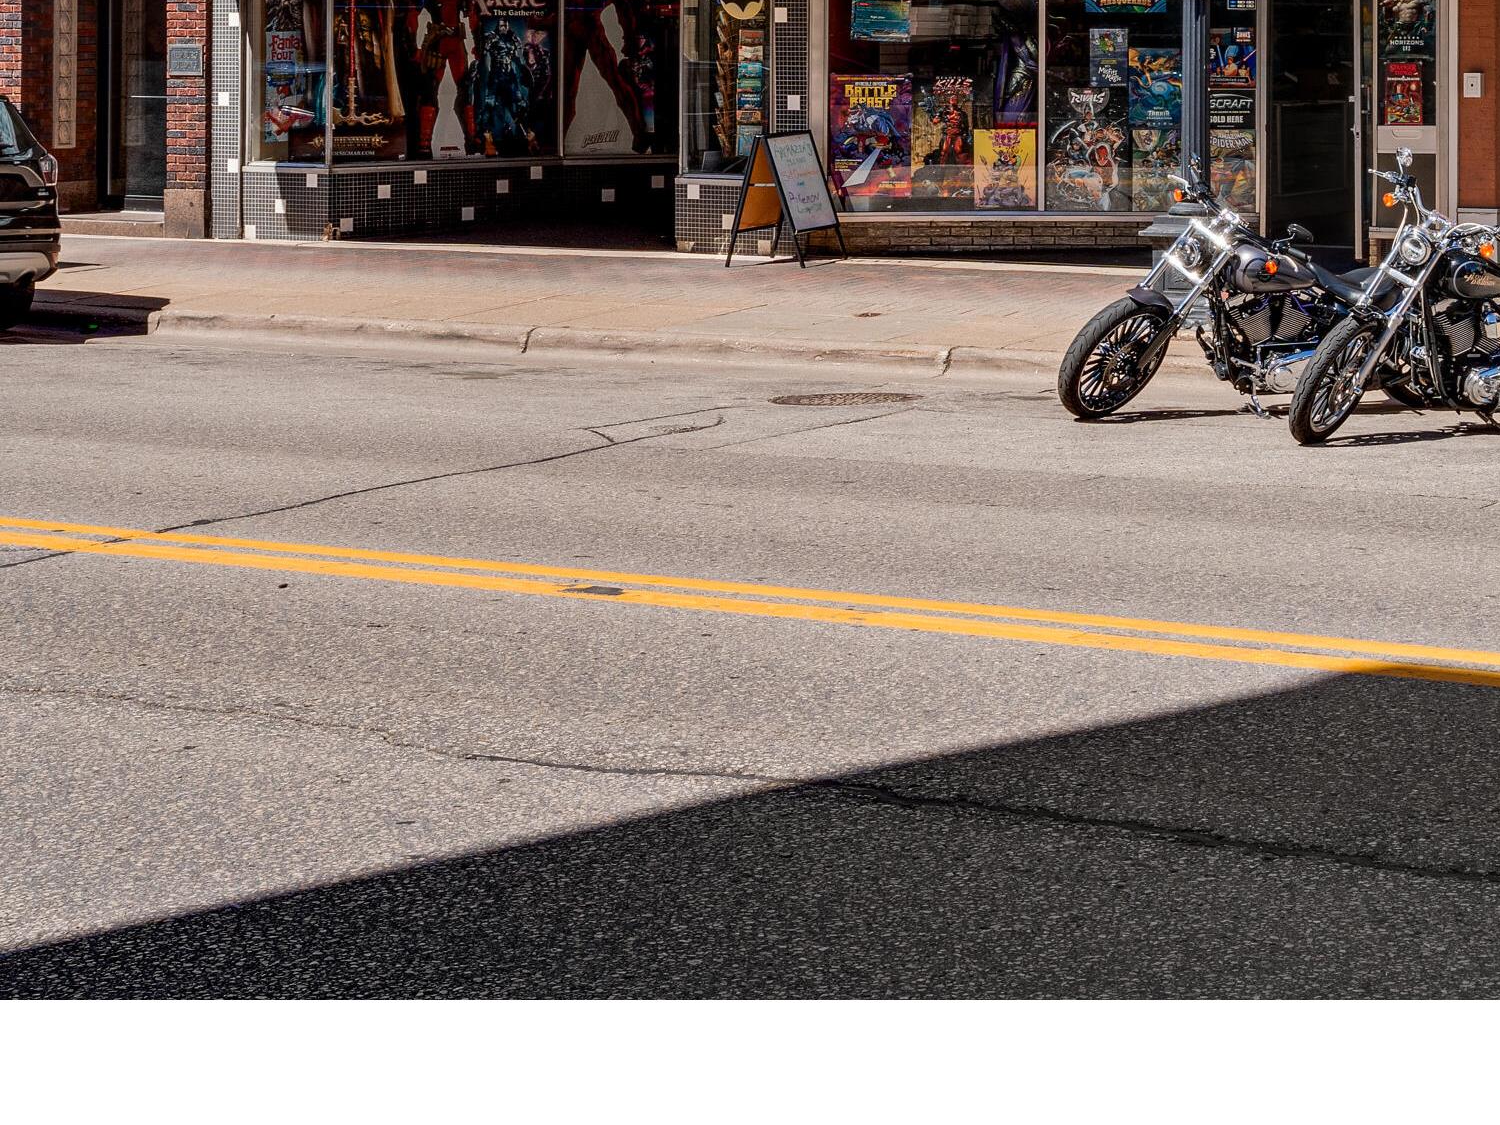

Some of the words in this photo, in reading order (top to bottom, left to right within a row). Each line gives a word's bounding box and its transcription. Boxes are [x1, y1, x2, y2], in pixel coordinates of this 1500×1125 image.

[508, 9, 545, 17] Gathering
[844, 84, 897, 98] BATTLE
[1070, 91, 1106, 104] RIVALS
[850, 97, 893, 110] BEAST
[1210, 115, 1226, 123] SOLD
[1226, 115, 1244, 123] HERE
